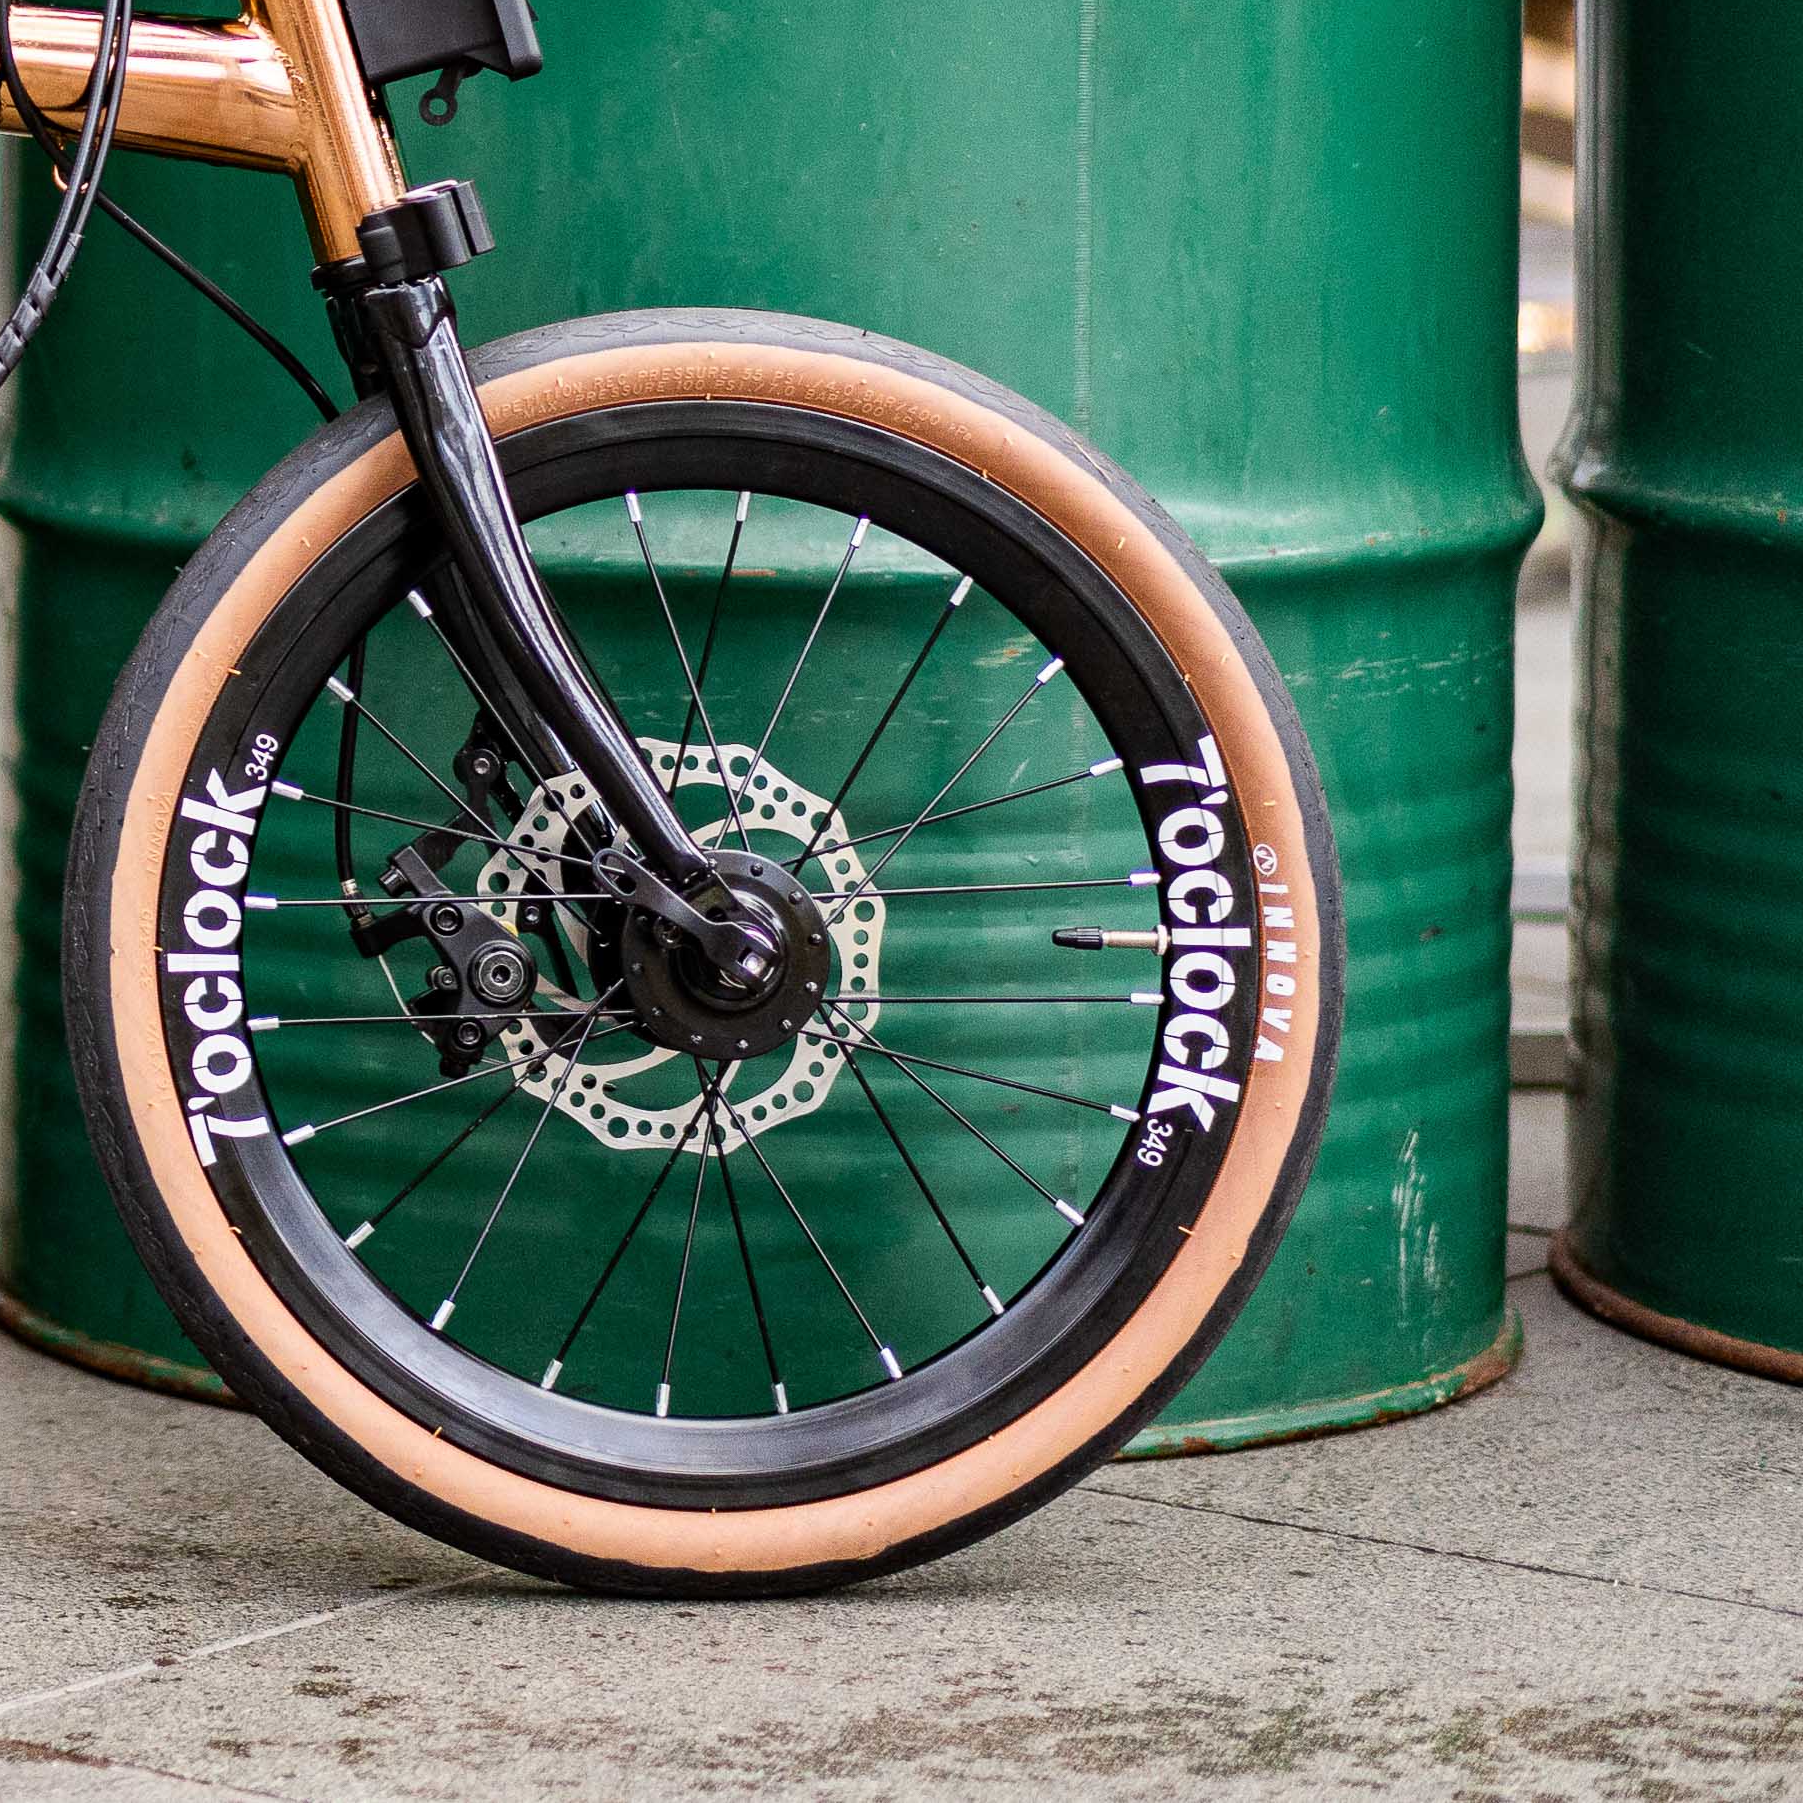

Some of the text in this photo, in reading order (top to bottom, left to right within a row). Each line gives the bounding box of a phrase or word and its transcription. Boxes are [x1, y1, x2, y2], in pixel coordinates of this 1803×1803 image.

[244, 733, 280, 781] 349
[1252, 882, 1297, 1064] INNOVA
[1137, 1118, 1174, 1168] 349
